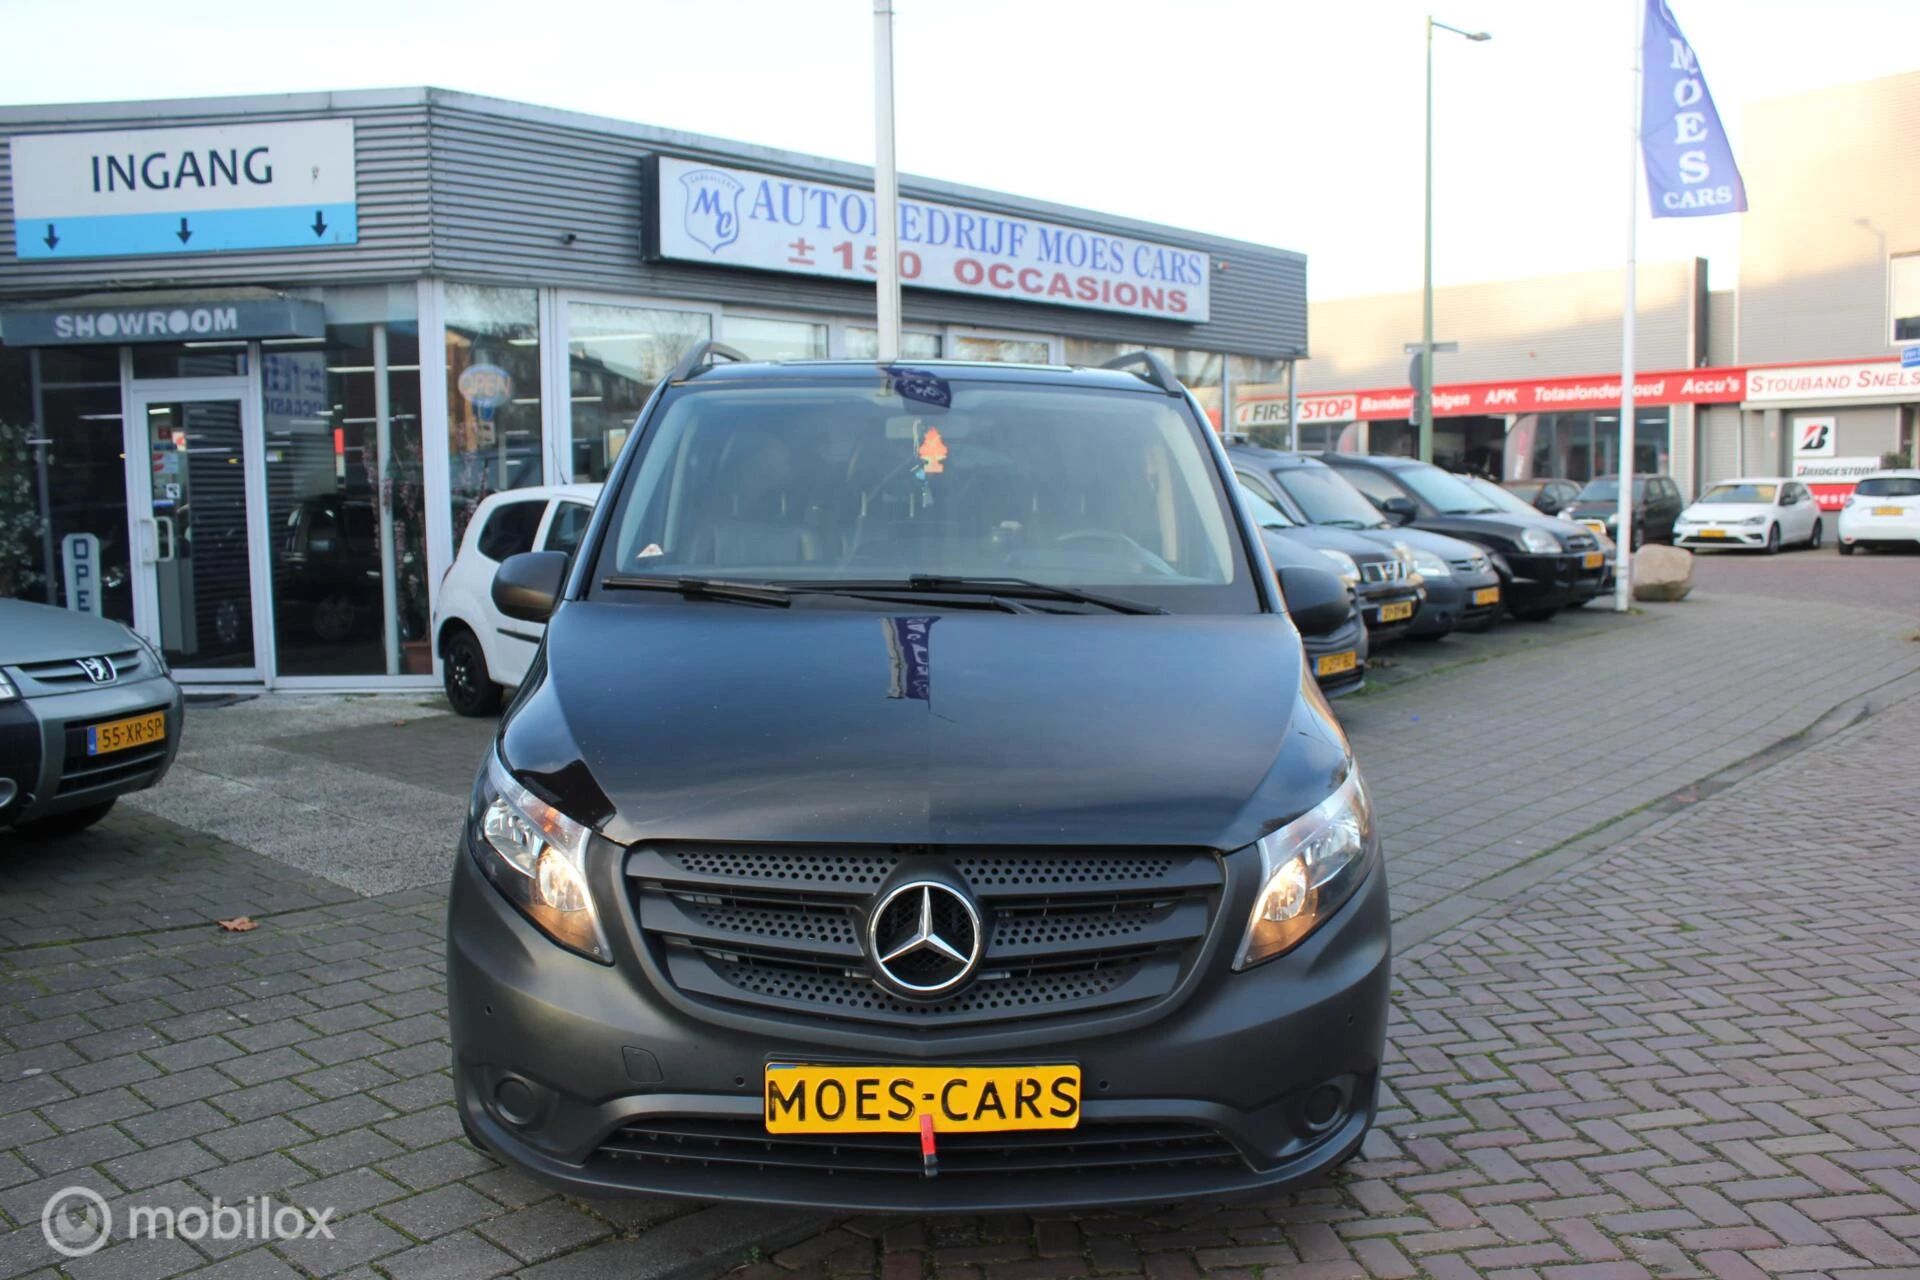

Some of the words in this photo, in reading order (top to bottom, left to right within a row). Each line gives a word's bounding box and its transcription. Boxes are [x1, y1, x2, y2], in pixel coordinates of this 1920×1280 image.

[1668, 37, 1710, 185] MOES
[91, 146, 273, 192] INGANG
[1663, 186, 1733, 209] CARS
[749, 179, 1028, 258] AUTOEDRIJF
[1037, 227, 1125, 275] MOES
[1133, 243, 1204, 287] CARS
[953, 257, 1188, 314] OCCASIONS
[55, 307, 239, 339] SHOWROOM
[1484, 388, 1518, 405] APK
[1534, 380, 1666, 403] Totaalonderoud
[1681, 377, 1740, 396] Accu's
[1750, 375, 1852, 394] STOUBAND
[1302, 399, 1353, 419] STOP
[102, 717, 162, 748] 55-XR-SP
[767, 1076, 1079, 1122] MOES-CARS
